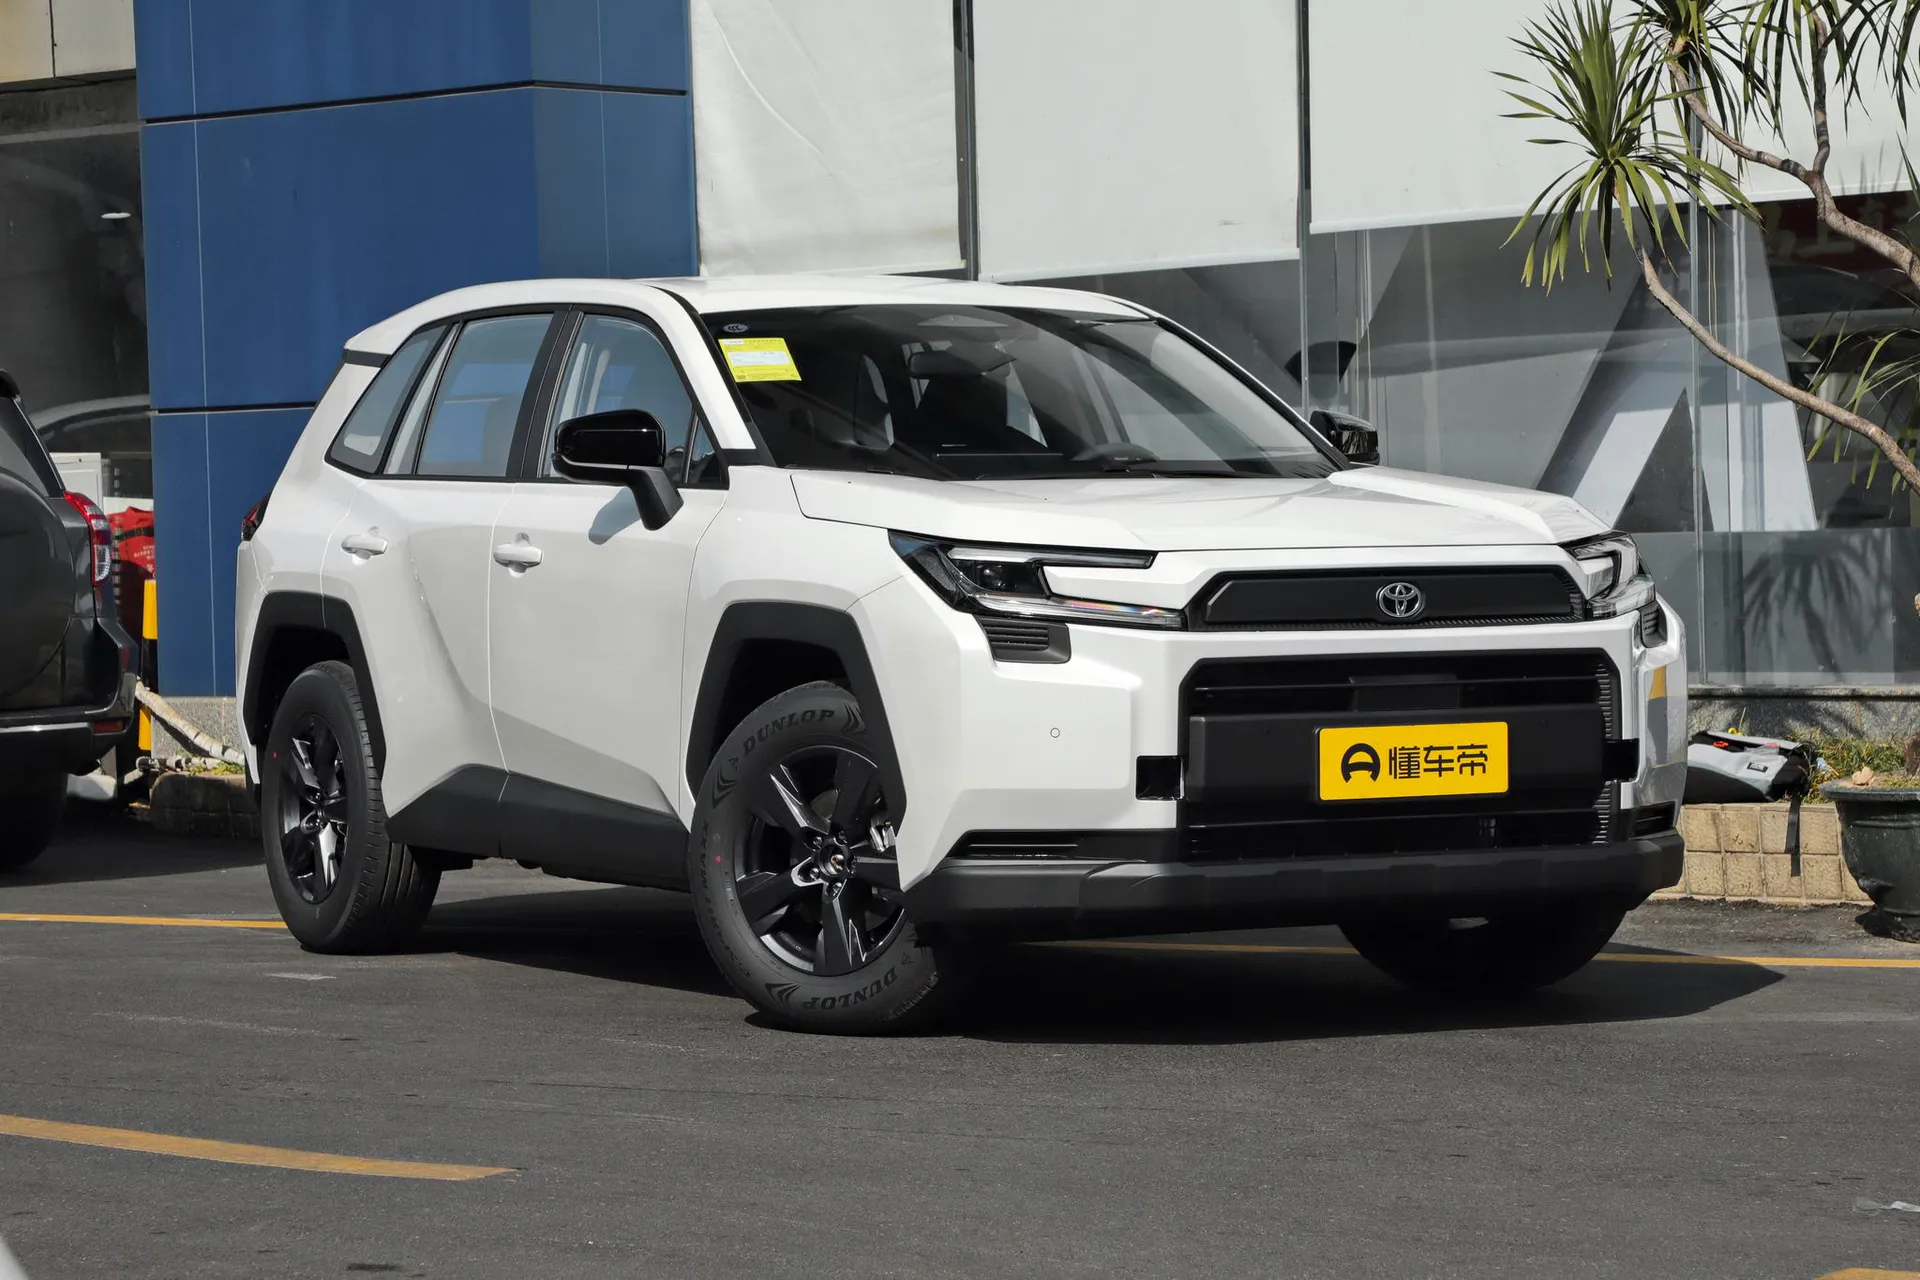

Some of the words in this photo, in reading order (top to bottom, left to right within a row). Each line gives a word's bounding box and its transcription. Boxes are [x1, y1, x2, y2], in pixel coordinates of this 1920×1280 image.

[742, 709, 835, 755] DUNLOP
[1389, 743, 1489, 780] 懂车帝
[803, 966, 898, 1010] DUNLOP
